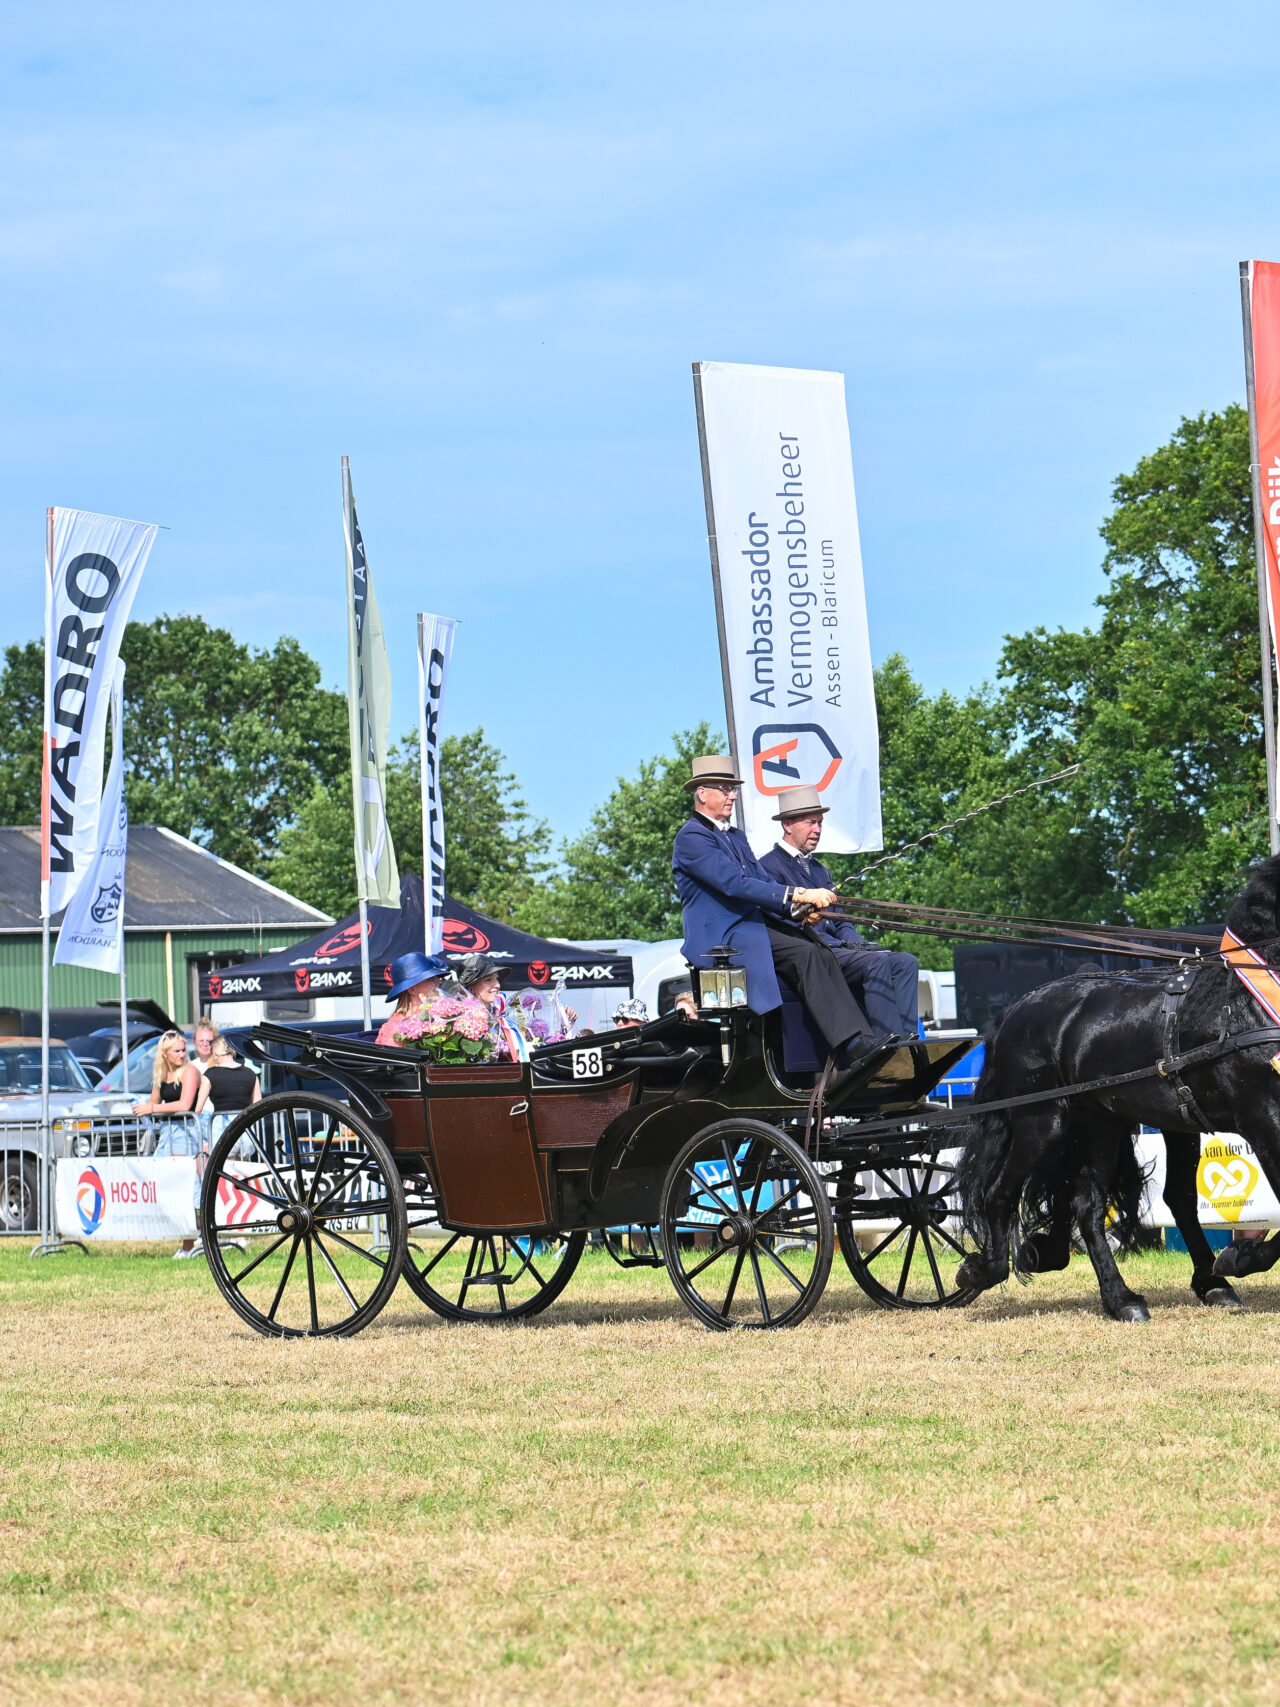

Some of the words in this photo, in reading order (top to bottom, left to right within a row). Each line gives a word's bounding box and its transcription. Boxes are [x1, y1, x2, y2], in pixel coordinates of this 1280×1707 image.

[775, 431, 818, 708] Vermogensbeheer
[820, 539, 839, 627] Blaricum
[741, 511, 776, 709] Ambassador
[824, 646, 842, 708] Assen
[50, 552, 121, 873] WADRO
[310, 971, 353, 988] 24MX
[550, 965, 614, 981] 24MX
[222, 976, 262, 995] 24MX
[575, 1052, 601, 1076] 58
[1205, 1146, 1223, 1158] van
[1225, 1142, 1243, 1156] der
[110, 1181, 138, 1203] HOS
[141, 1181, 157, 1204] Oil
